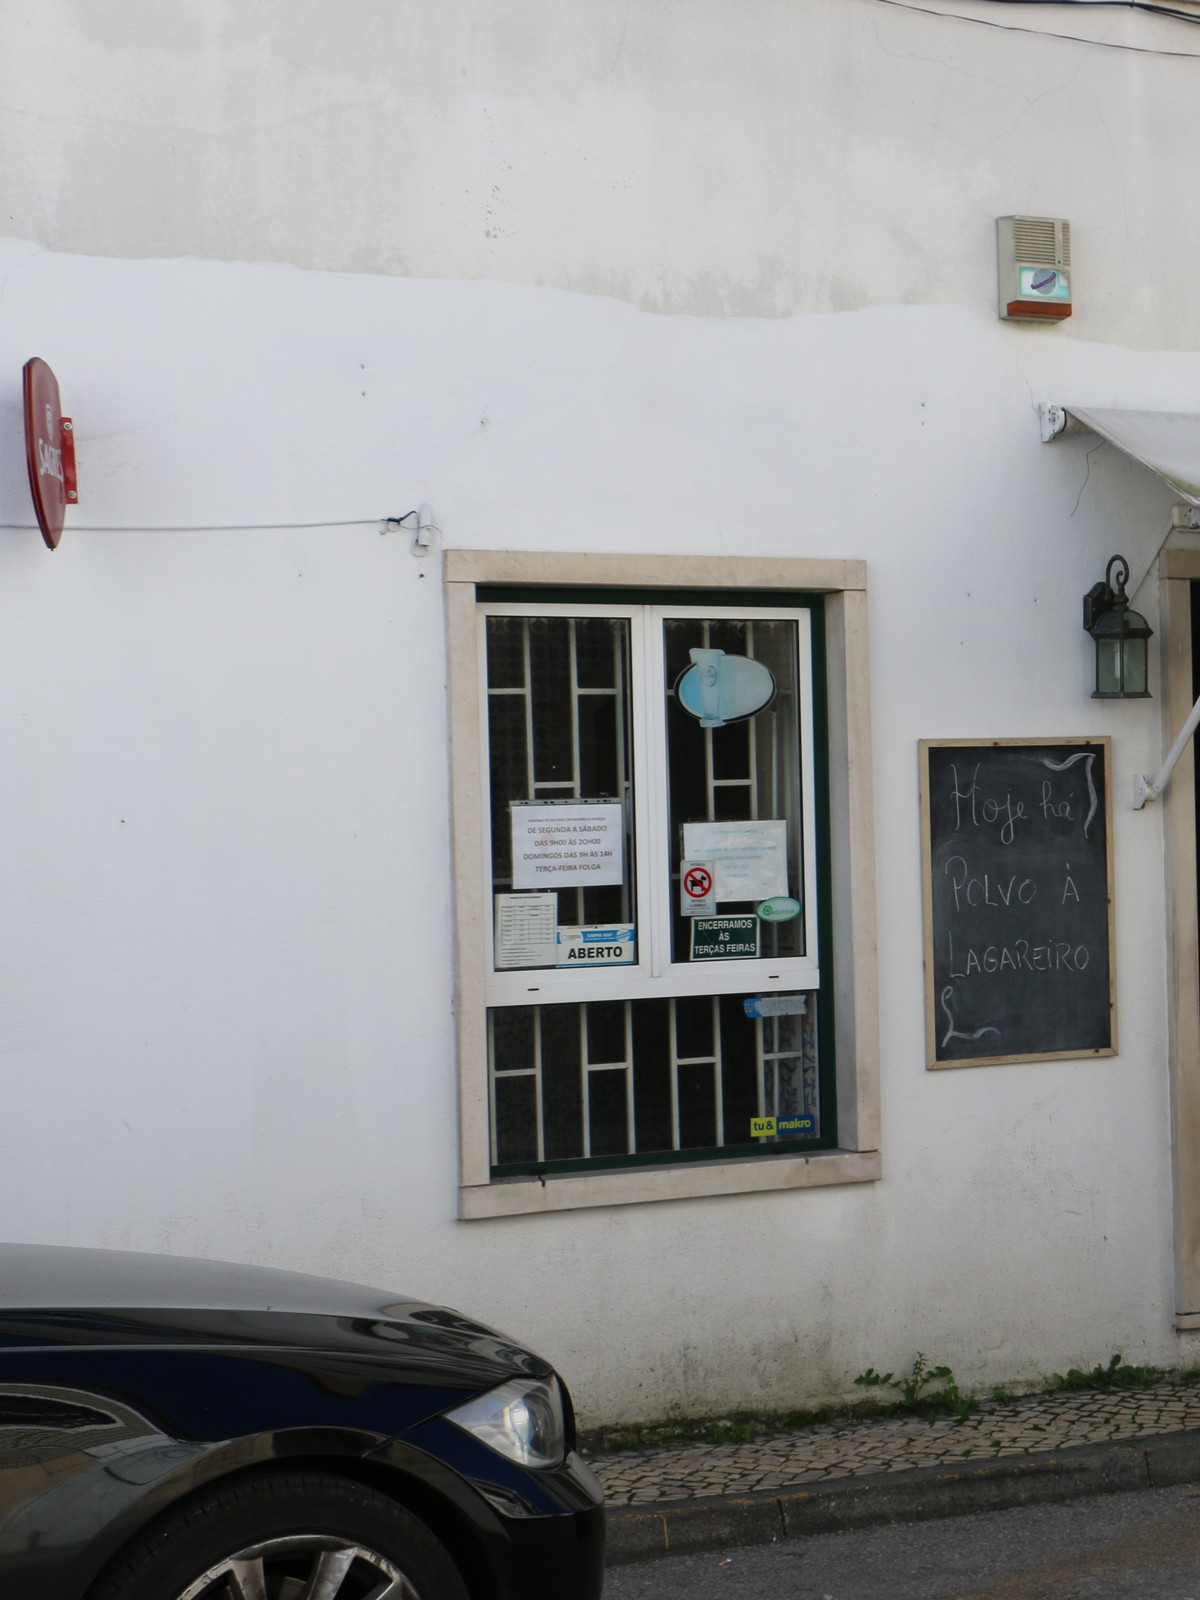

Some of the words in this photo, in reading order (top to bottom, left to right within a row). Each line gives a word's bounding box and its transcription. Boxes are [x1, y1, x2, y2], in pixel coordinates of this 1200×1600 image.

[950, 762, 1028, 845] Hoje
[1039, 780, 1075, 821] há
[538, 826, 571, 834] SEGUNDA
[535, 864, 578, 873] TERÇA-FEIRA
[579, 863, 601, 871] FOLGA
[945, 855, 1037, 912] POLVO
[698, 920, 753, 930] ENCERRAMOS
[718, 930, 730, 941] ÀS
[567, 946, 623, 960] ABERTO
[694, 944, 725, 955] TERÇAS
[726, 943, 756, 953] FEIRAS
[753, 1121, 764, 1131] tu
[766, 1120, 773, 1130] &
[778, 1118, 811, 1129] makro
